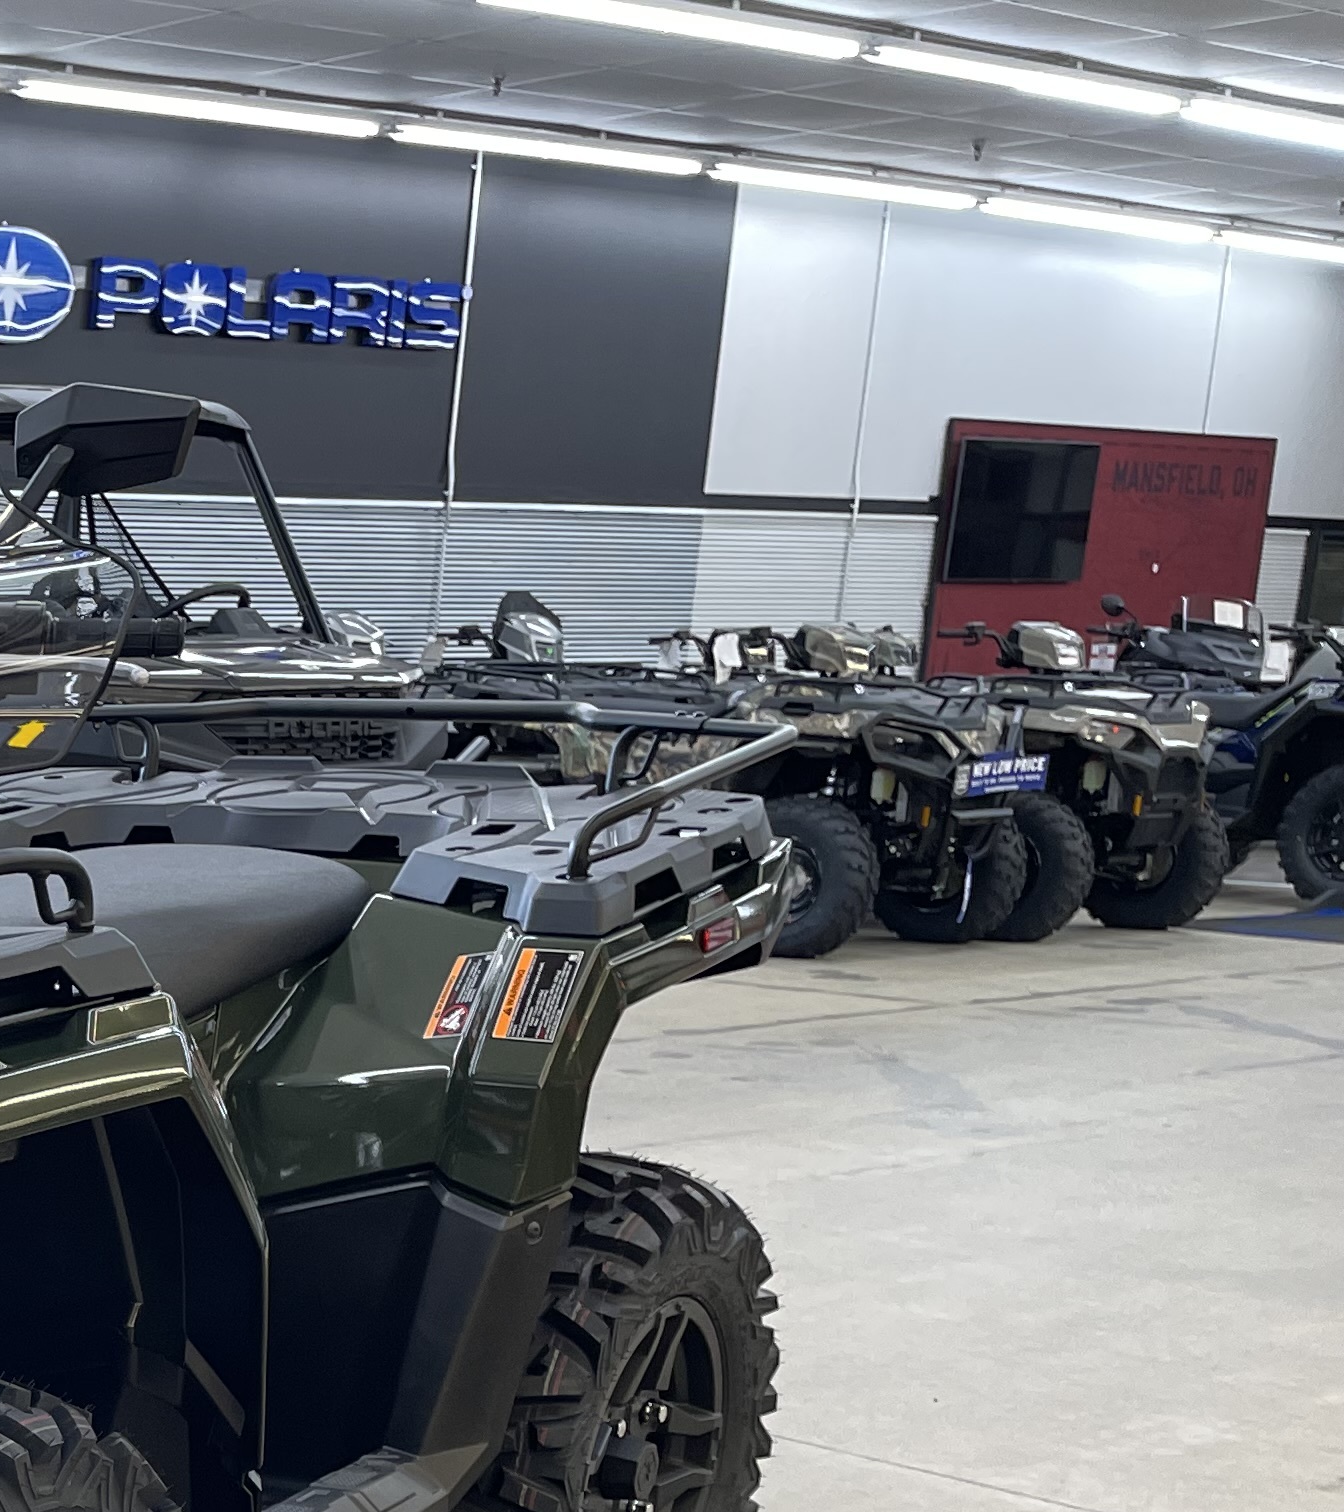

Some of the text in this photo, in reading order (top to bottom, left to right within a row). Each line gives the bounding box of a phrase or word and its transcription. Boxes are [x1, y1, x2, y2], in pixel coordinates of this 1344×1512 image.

[88, 256, 464, 350] POLARIS
[1112, 461, 1258, 499] MANSFIELD, OH
[1014, 757, 1046, 774] PRICE
[506, 969, 526, 1006] WARNING
